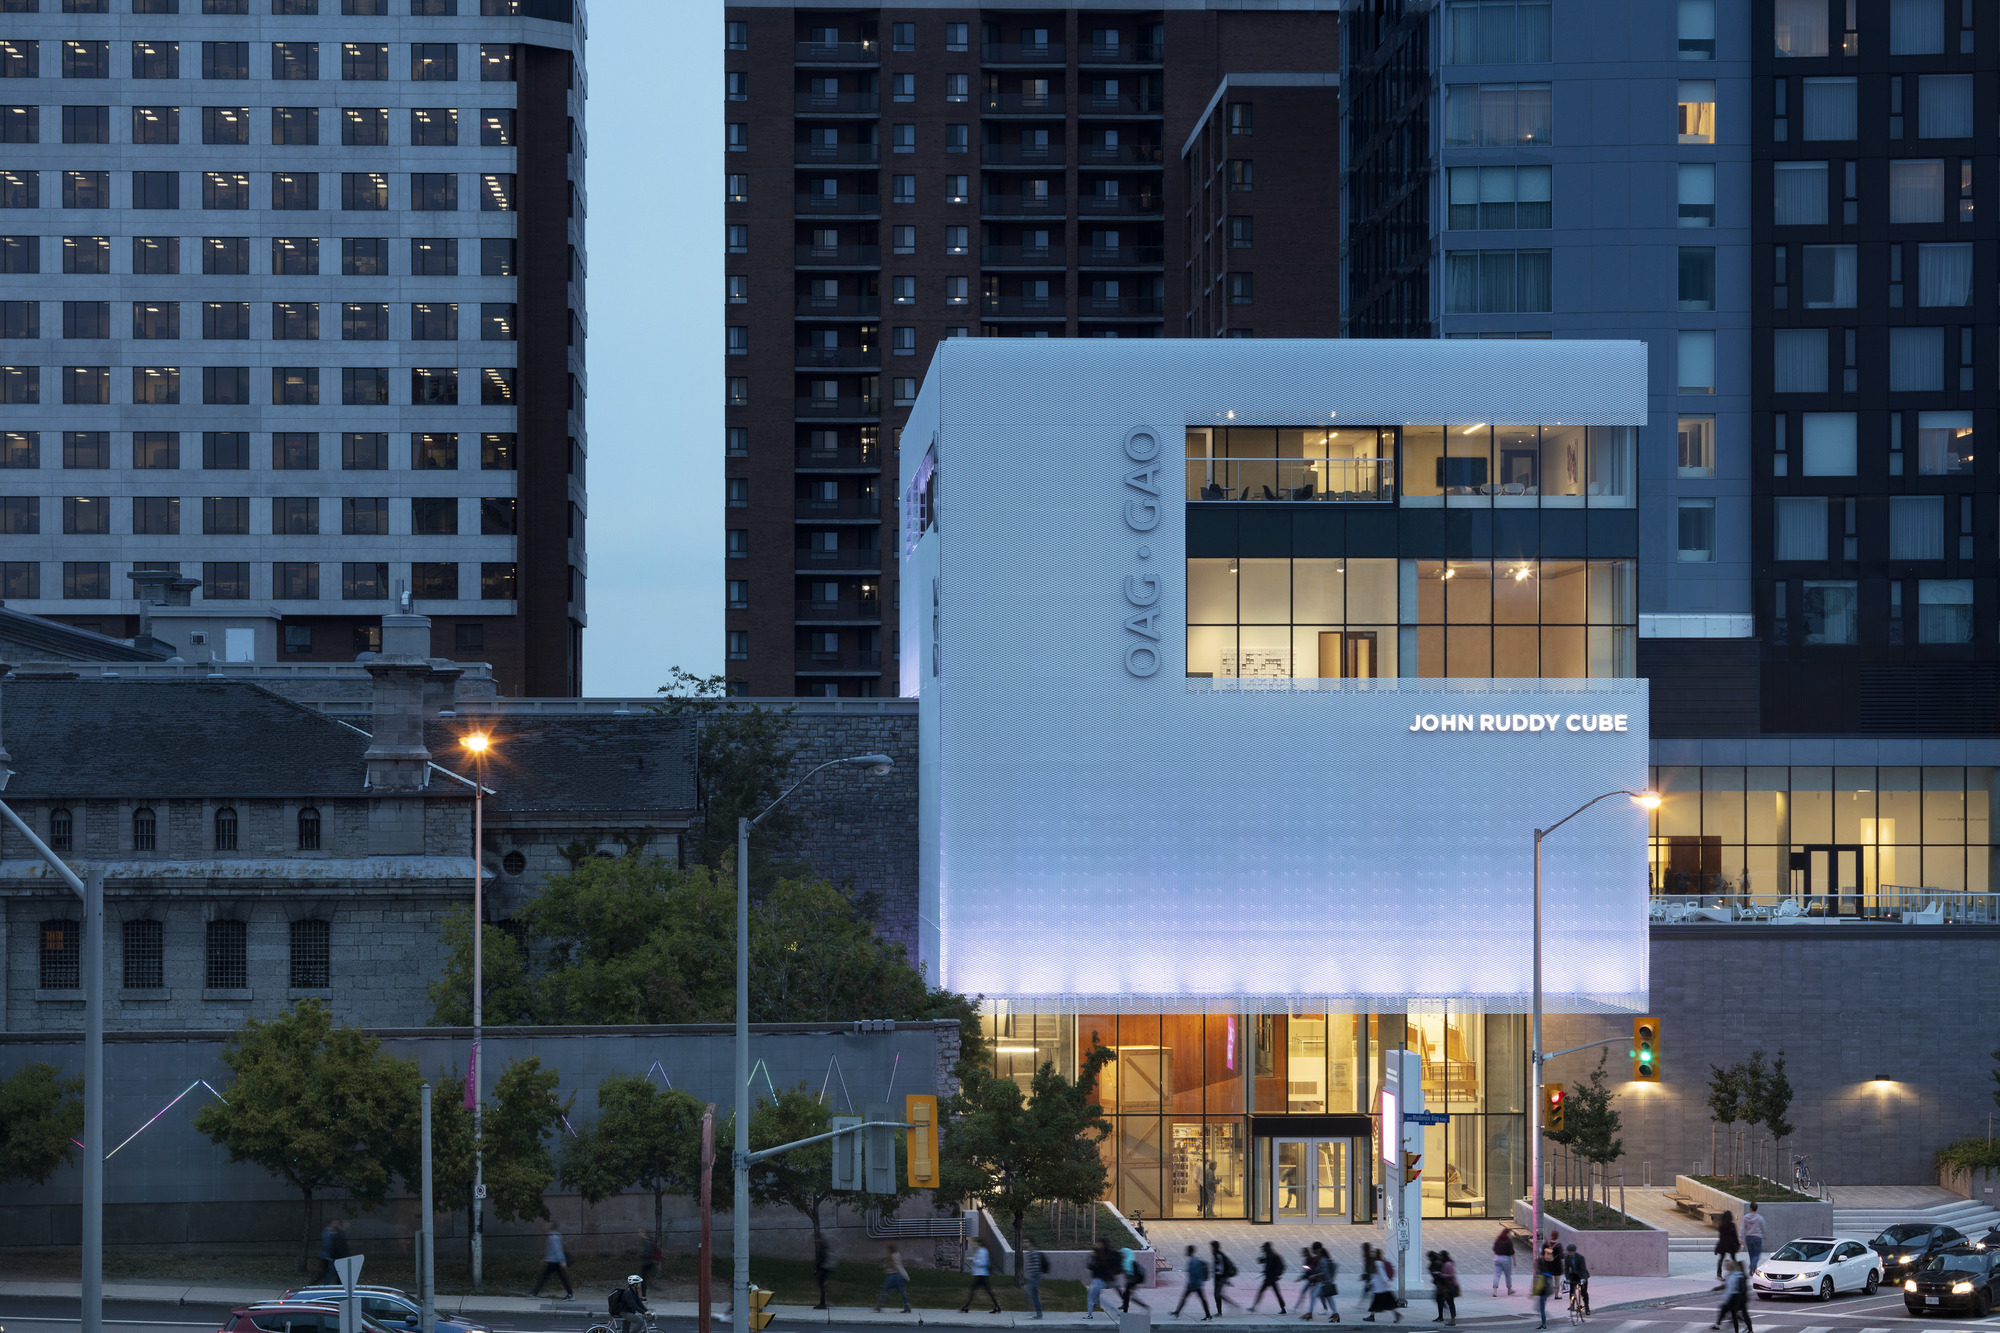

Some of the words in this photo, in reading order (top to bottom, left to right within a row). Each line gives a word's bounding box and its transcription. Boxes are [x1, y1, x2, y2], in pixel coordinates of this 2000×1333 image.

[1124, 424, 1162, 532] GAO
[1124, 573, 1162, 678] OAG
[1409, 713, 1474, 732] JOHN
[1480, 713, 1561, 732] RUDDY
[1565, 713, 1628, 732] CUBE
